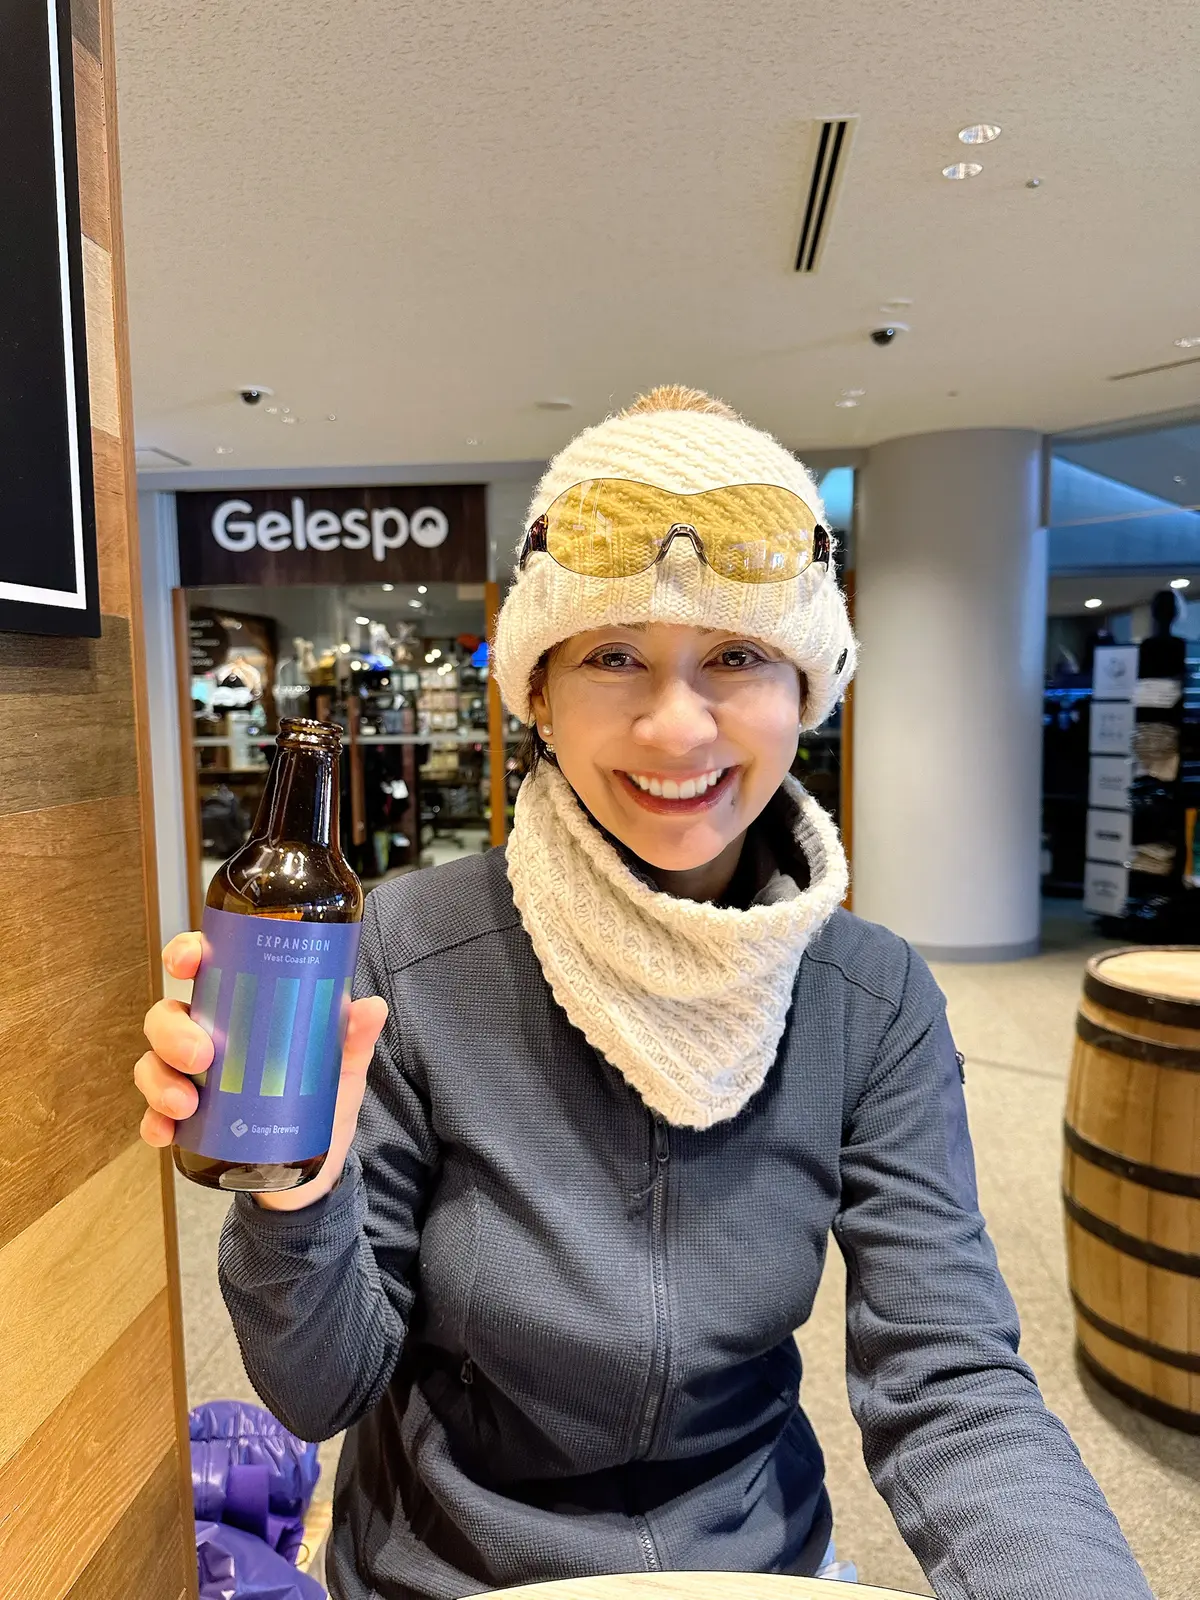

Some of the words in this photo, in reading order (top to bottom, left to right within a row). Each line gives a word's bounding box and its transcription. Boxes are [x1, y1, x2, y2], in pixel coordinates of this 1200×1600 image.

[211, 497, 449, 561] Gelespo
[257, 934, 330, 951] EXPANSION
[263, 952, 283, 963] West
[284, 954, 306, 964] Coast
[307, 956, 320, 965] IPA
[251, 1124, 272, 1136] Gangi
[272, 1124, 299, 1135] Brewing
